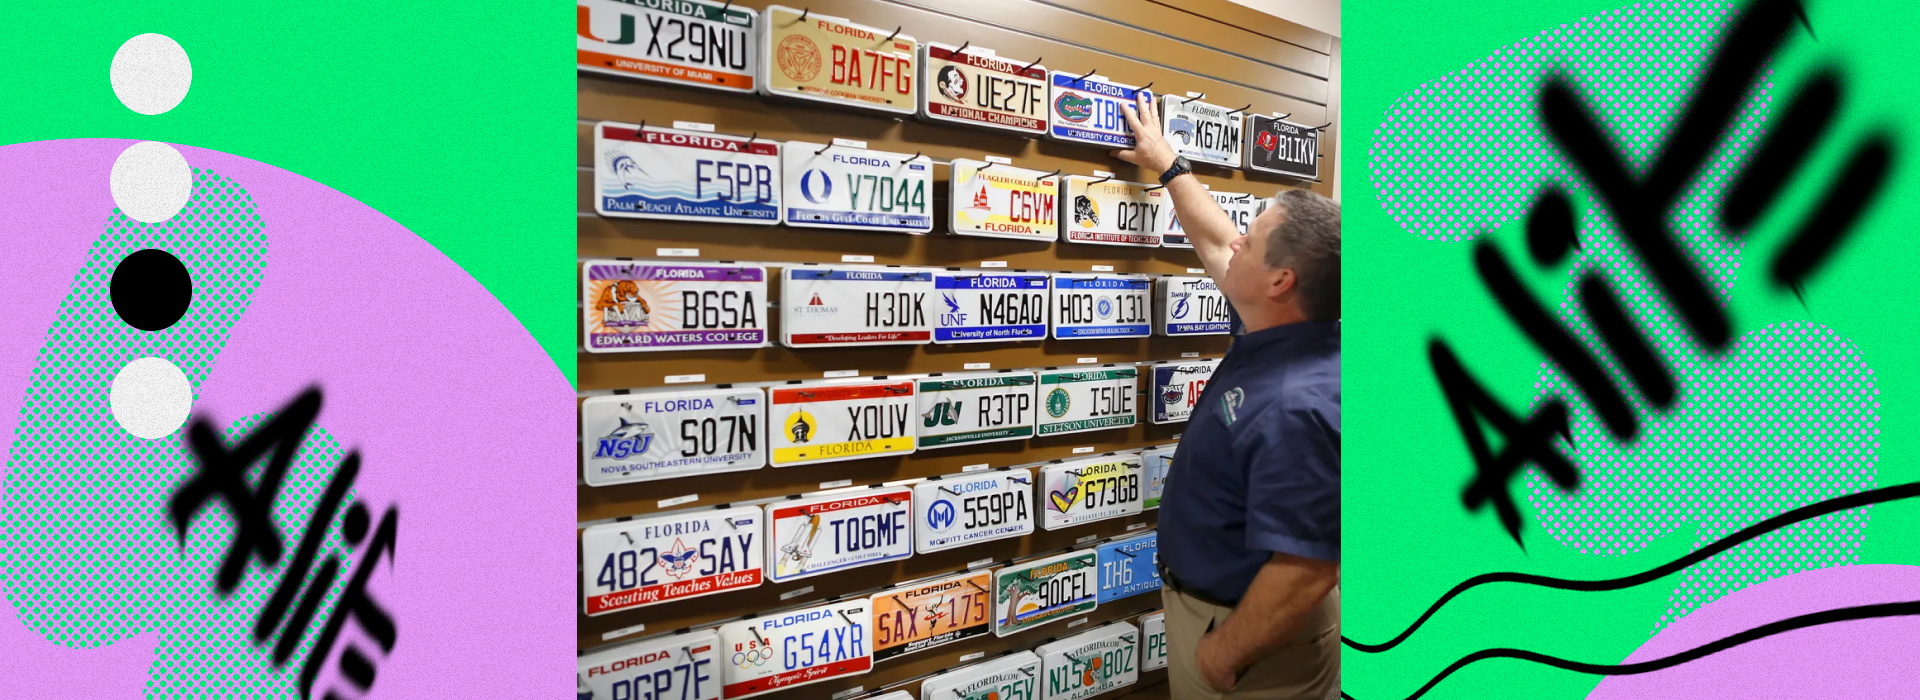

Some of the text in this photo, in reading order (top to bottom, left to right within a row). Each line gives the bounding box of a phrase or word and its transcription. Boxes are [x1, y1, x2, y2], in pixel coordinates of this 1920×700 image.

[622, 0, 707, 18] LORIDA
[817, 20, 876, 42] FLORIDA
[646, 13, 746, 70] X29NU
[616, 59, 714, 81] UNIVERSITY OF MIAMI
[830, 44, 911, 95] BA7FG
[966, 54, 1014, 74] FLORIDA
[976, 72, 1043, 116] UE27F
[1084, 80, 1125, 97] FLORIDA
[941, 105, 987, 121] NATIONAL
[1191, 105, 1220, 118] FLORIDA
[1195, 119, 1239, 154] K67AM
[1273, 122, 1299, 135] FLORIDA
[646, 132, 739, 151] FLORIDA
[833, 154, 891, 168] FLORIDA
[695, 158, 772, 203] F5PB
[978, 173, 1041, 188] FLAGLER COLLEGE
[847, 173, 925, 214] V7044
[1103, 185, 1133, 196] FLORIDA
[675, 203, 721, 216] ATLANTIC
[1010, 189, 1054, 225] C6VM
[855, 213, 880, 225] COAST
[1117, 201, 1160, 233] Q2TY
[985, 222, 1032, 234] FLORIDA
[1095, 232, 1121, 242] INSTITUTE
[1121, 234, 1128, 242] OF
[655, 269, 705, 279] FLORIDA
[846, 271, 883, 280] FLORIDA
[970, 278, 1017, 288] FLORIDA
[1191, 282, 1219, 291] FLORID
[682, 290, 757, 329] B6SA
[805, 306, 838, 314] THOMAS
[866, 292, 926, 327] H3DK
[980, 293, 1043, 325] N46AQ
[1115, 294, 1146, 324] 131
[941, 313, 967, 326] UNF
[655, 332, 703, 343] WATERS
[985, 329, 993, 337] of
[645, 398, 714, 413] FLORIDA
[924, 401, 963, 428] JU
[978, 392, 1029, 428] R3TP
[945, 430, 1009, 442] JACKSONVILLE UNIVERSITY
[1043, 421, 1082, 434] STETSON
[591, 433, 654, 460] NSU
[820, 442, 873, 456] FLORIDA
[601, 452, 753, 474] NOVA SOUTHEASTERN UNIVERSITY
[1074, 463, 1117, 478] FLORIDA
[953, 480, 998, 494] FLORIDA
[1085, 473, 1139, 510] 673GB
[810, 496, 879, 513] FLORIDA
[963, 490, 1028, 530] 559PA
[644, 519, 710, 540] FLORIDA
[830, 510, 906, 555] TQ6MF
[963, 527, 994, 540] CANCER
[1123, 540, 1157, 553] FLORID
[597, 532, 753, 592] 482 SAY
[806, 551, 882, 570] CHALLENGER COLUMBIA
[1029, 561, 1069, 582] FLORIDA
[1102, 558, 1133, 590] IH6
[599, 571, 754, 609] Scouting Teaches Values
[905, 580, 962, 599] FLORIDA
[1123, 578, 1160, 594] ANTIQUE
[763, 608, 834, 631] FLORIDA
[878, 591, 985, 646] SAX 175
[932, 631, 954, 641] Florida
[783, 623, 864, 671] G54XR
[588, 649, 671, 679] FLORIDA
[768, 671, 803, 687] Olympic
[803, 665, 829, 680] Spirit
[1049, 659, 1083, 697] N15
[1070, 681, 1114, 700] ALACHUA
